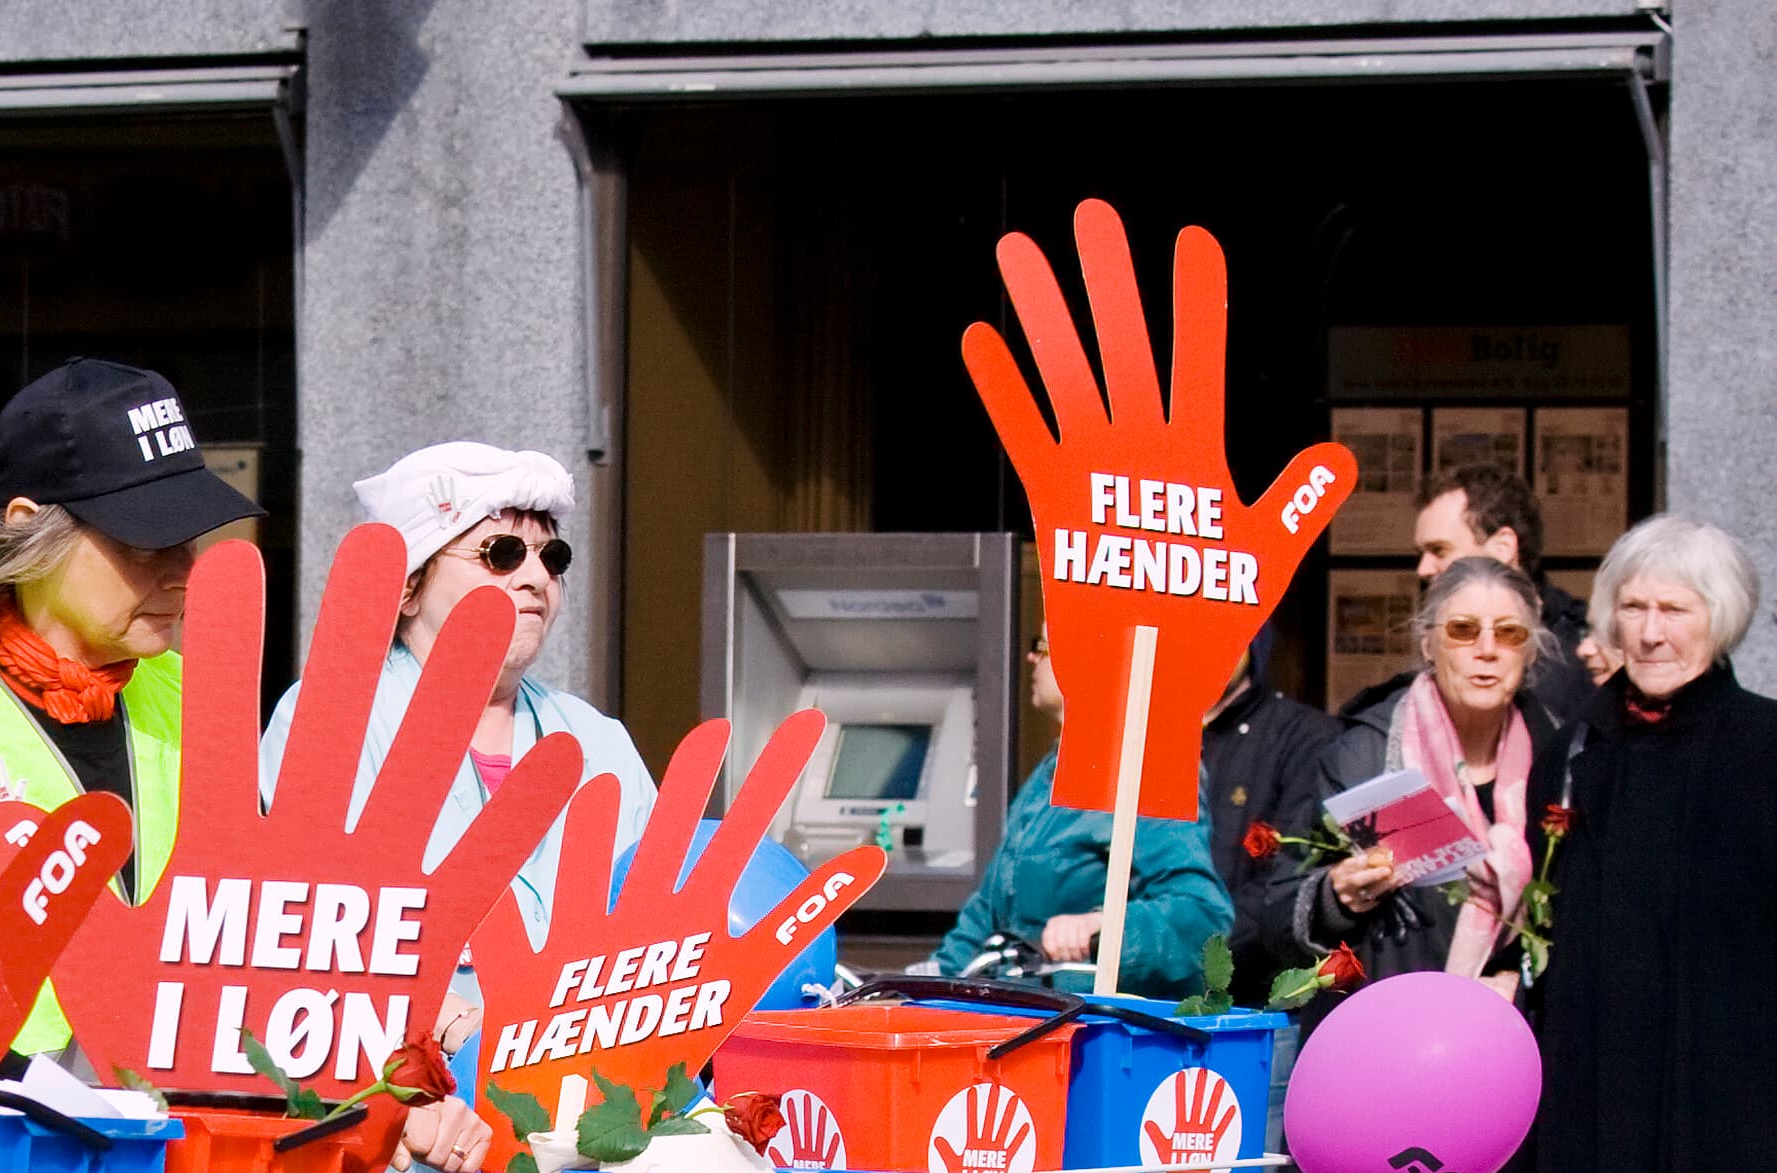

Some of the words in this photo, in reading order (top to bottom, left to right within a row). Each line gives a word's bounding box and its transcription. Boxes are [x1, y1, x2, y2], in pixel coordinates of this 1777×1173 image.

[127, 397, 183, 435] MERE
[138, 435, 154, 461] I
[155, 425, 195, 457] LØN
[1090, 472, 1223, 540] FLERE
[1281, 465, 1336, 535] FOA
[1053, 528, 1259, 604] HÆNDER
[23, 820, 101, 926] FOA
[775, 871, 855, 946] FOA
[159, 875, 428, 977] MERE
[548, 931, 712, 1008] FLERE
[147, 980, 185, 1072] I
[210, 984, 411, 1082] LØN
[489, 979, 732, 1073] HÆNDER
[963, 1149, 1007, 1169] MERE
[1172, 1132, 1215, 1151] MERE
